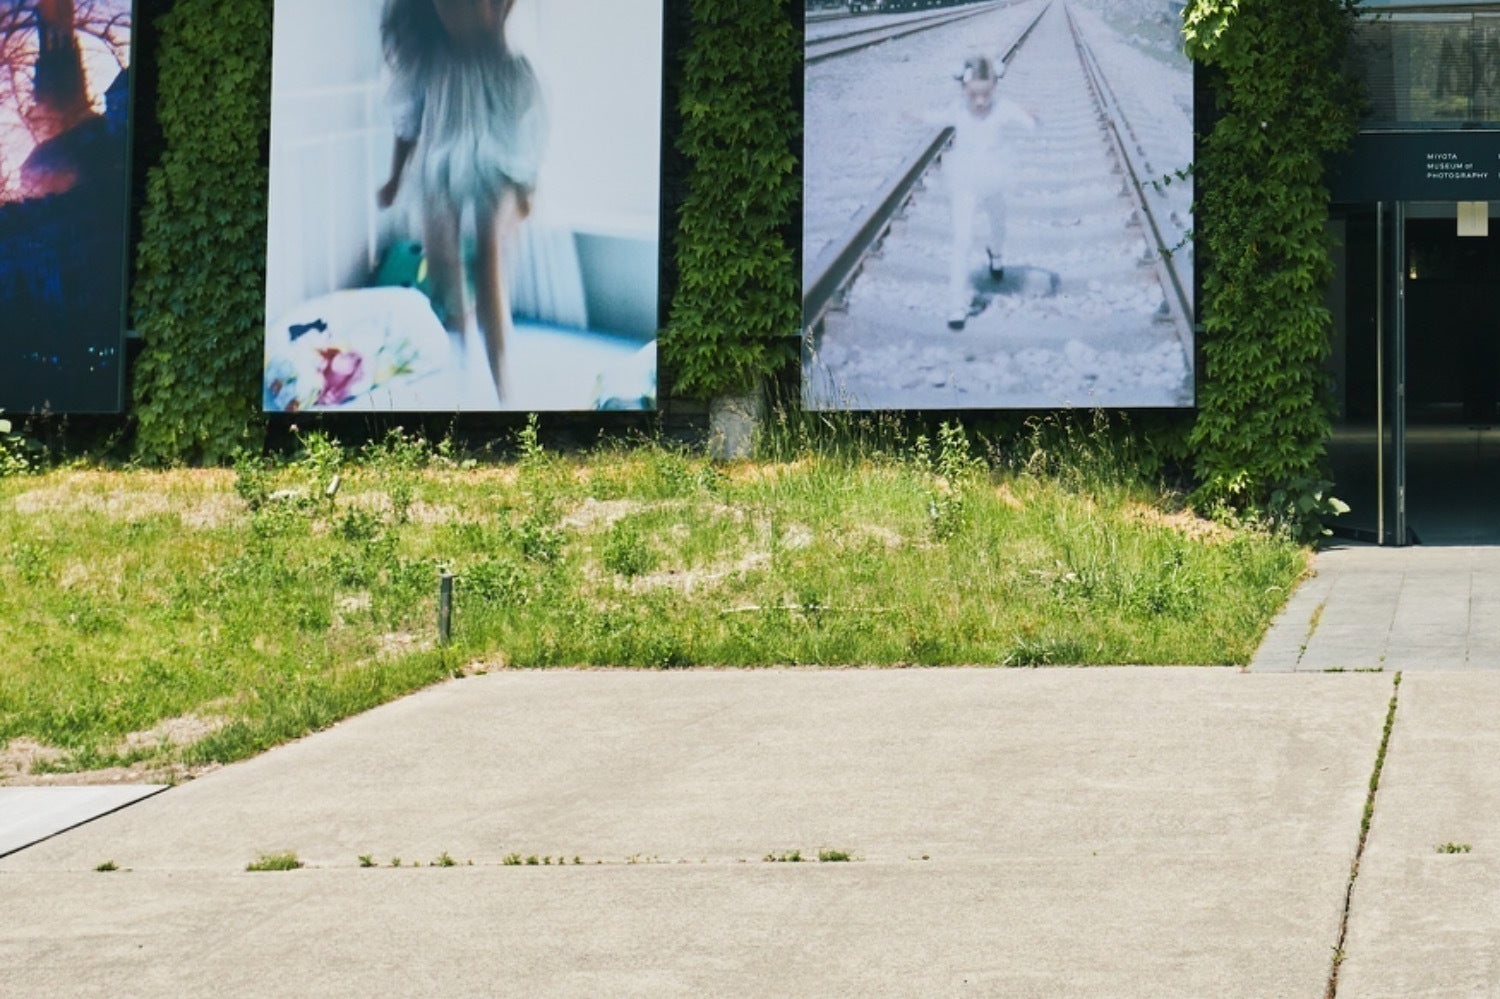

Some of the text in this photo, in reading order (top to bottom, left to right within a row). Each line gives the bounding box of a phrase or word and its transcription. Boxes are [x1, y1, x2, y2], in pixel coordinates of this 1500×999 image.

[1426, 152, 1458, 160] MIYOTA
[1426, 162, 1463, 170] MUSEUM
[1426, 171, 1488, 179] PHOTOGRAPHY
